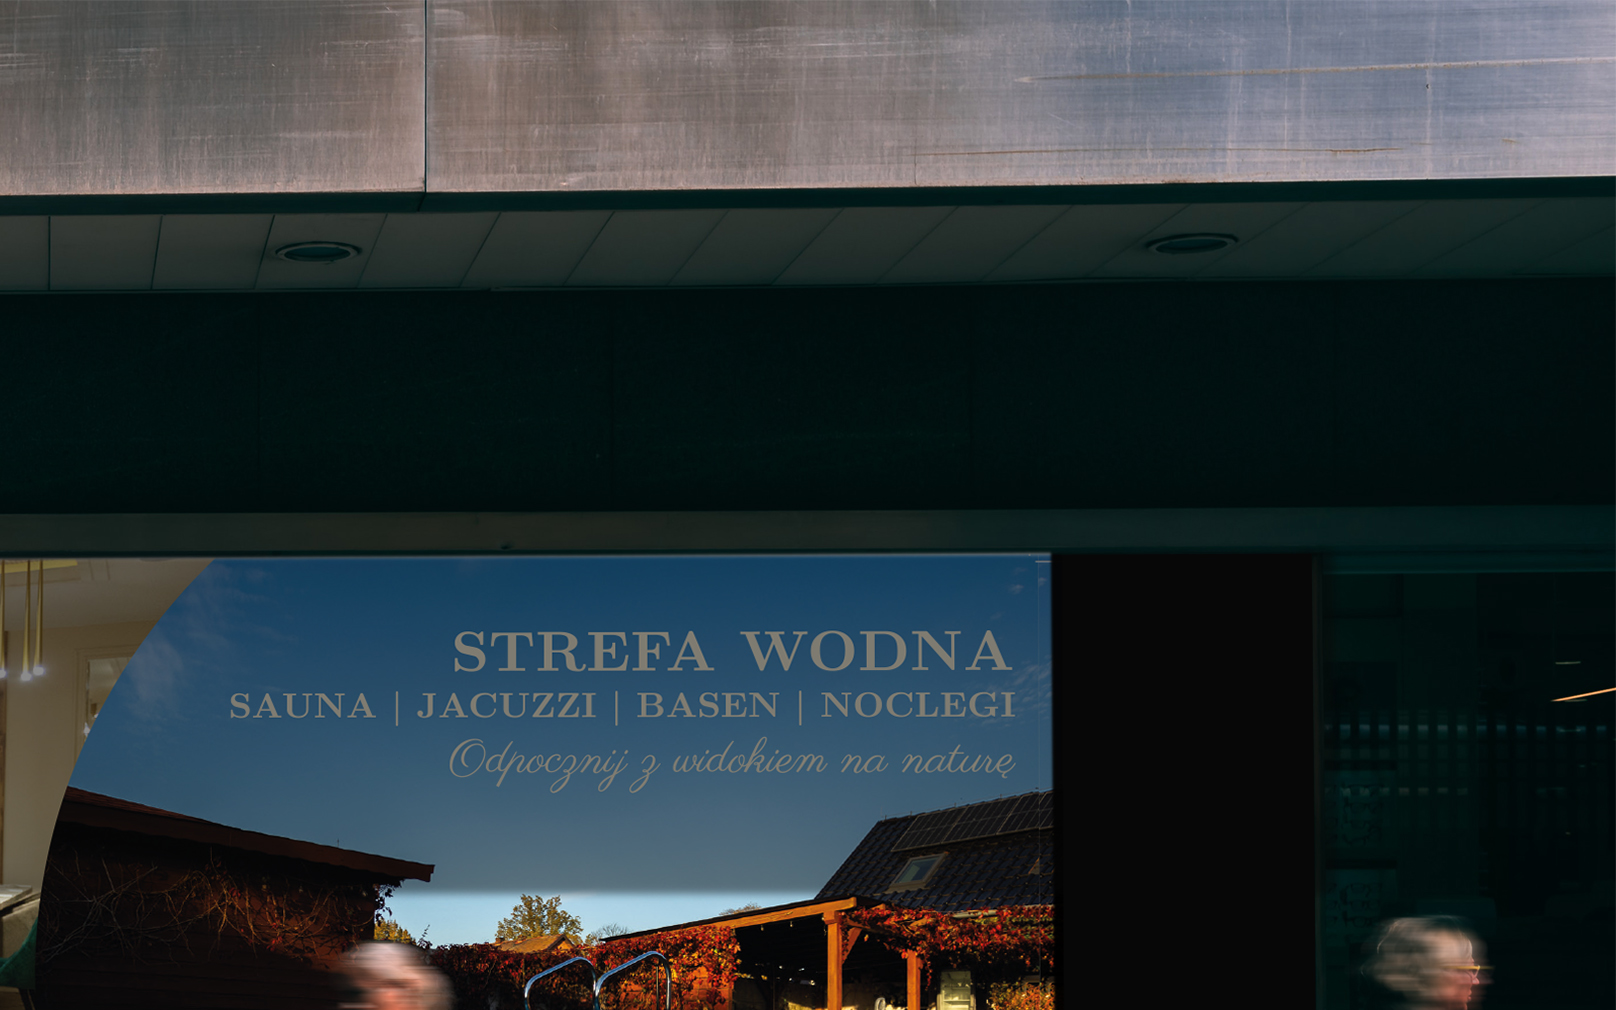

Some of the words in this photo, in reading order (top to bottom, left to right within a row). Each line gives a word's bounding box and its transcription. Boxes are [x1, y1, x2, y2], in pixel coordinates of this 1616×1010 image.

[454, 630, 715, 673] STREFA
[739, 629, 1013, 672] WODNA
[230, 692, 377, 719] SAUNA
[416, 692, 597, 719] JACUZZI
[636, 691, 780, 718] BASEN
[820, 691, 1016, 718] NOCLEGI
[449, 738, 629, 793] Odpocznij
[629, 754, 661, 793] z
[672, 736, 828, 774] widokiem
[840, 754, 889, 773] na
[901, 744, 1016, 778] naturę
